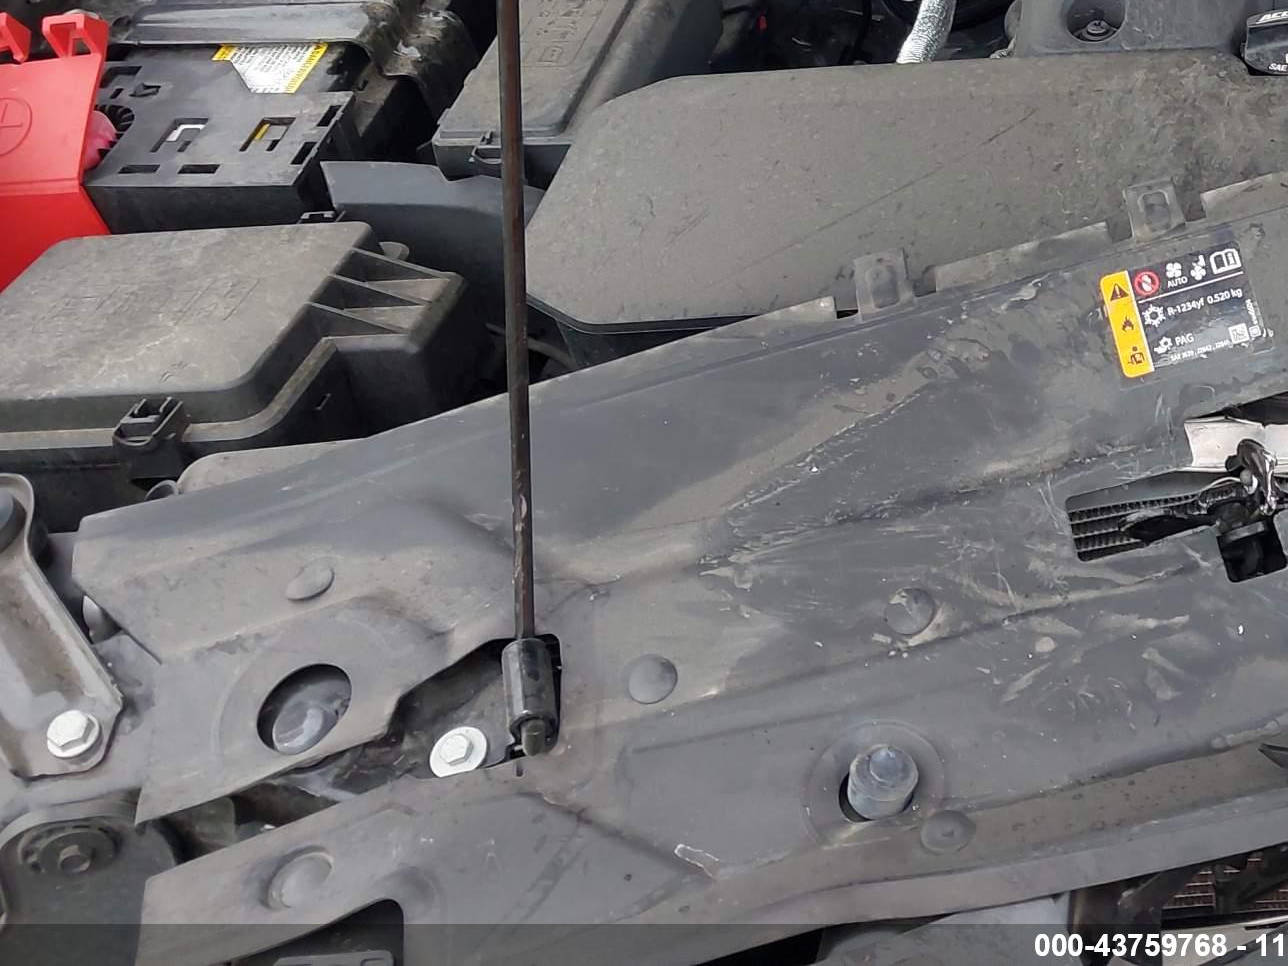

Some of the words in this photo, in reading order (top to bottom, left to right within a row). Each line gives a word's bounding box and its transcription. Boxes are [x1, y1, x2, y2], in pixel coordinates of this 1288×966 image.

[1269, 63, 1288, 71] SAE
[1167, 276, 1188, 288] AUTO
[1167, 297, 1205, 316] R-1234yf
[1206, 291, 1231, 305] 0.520
[1230, 288, 1243, 298] kg
[1174, 333, 1195, 346] PAG
